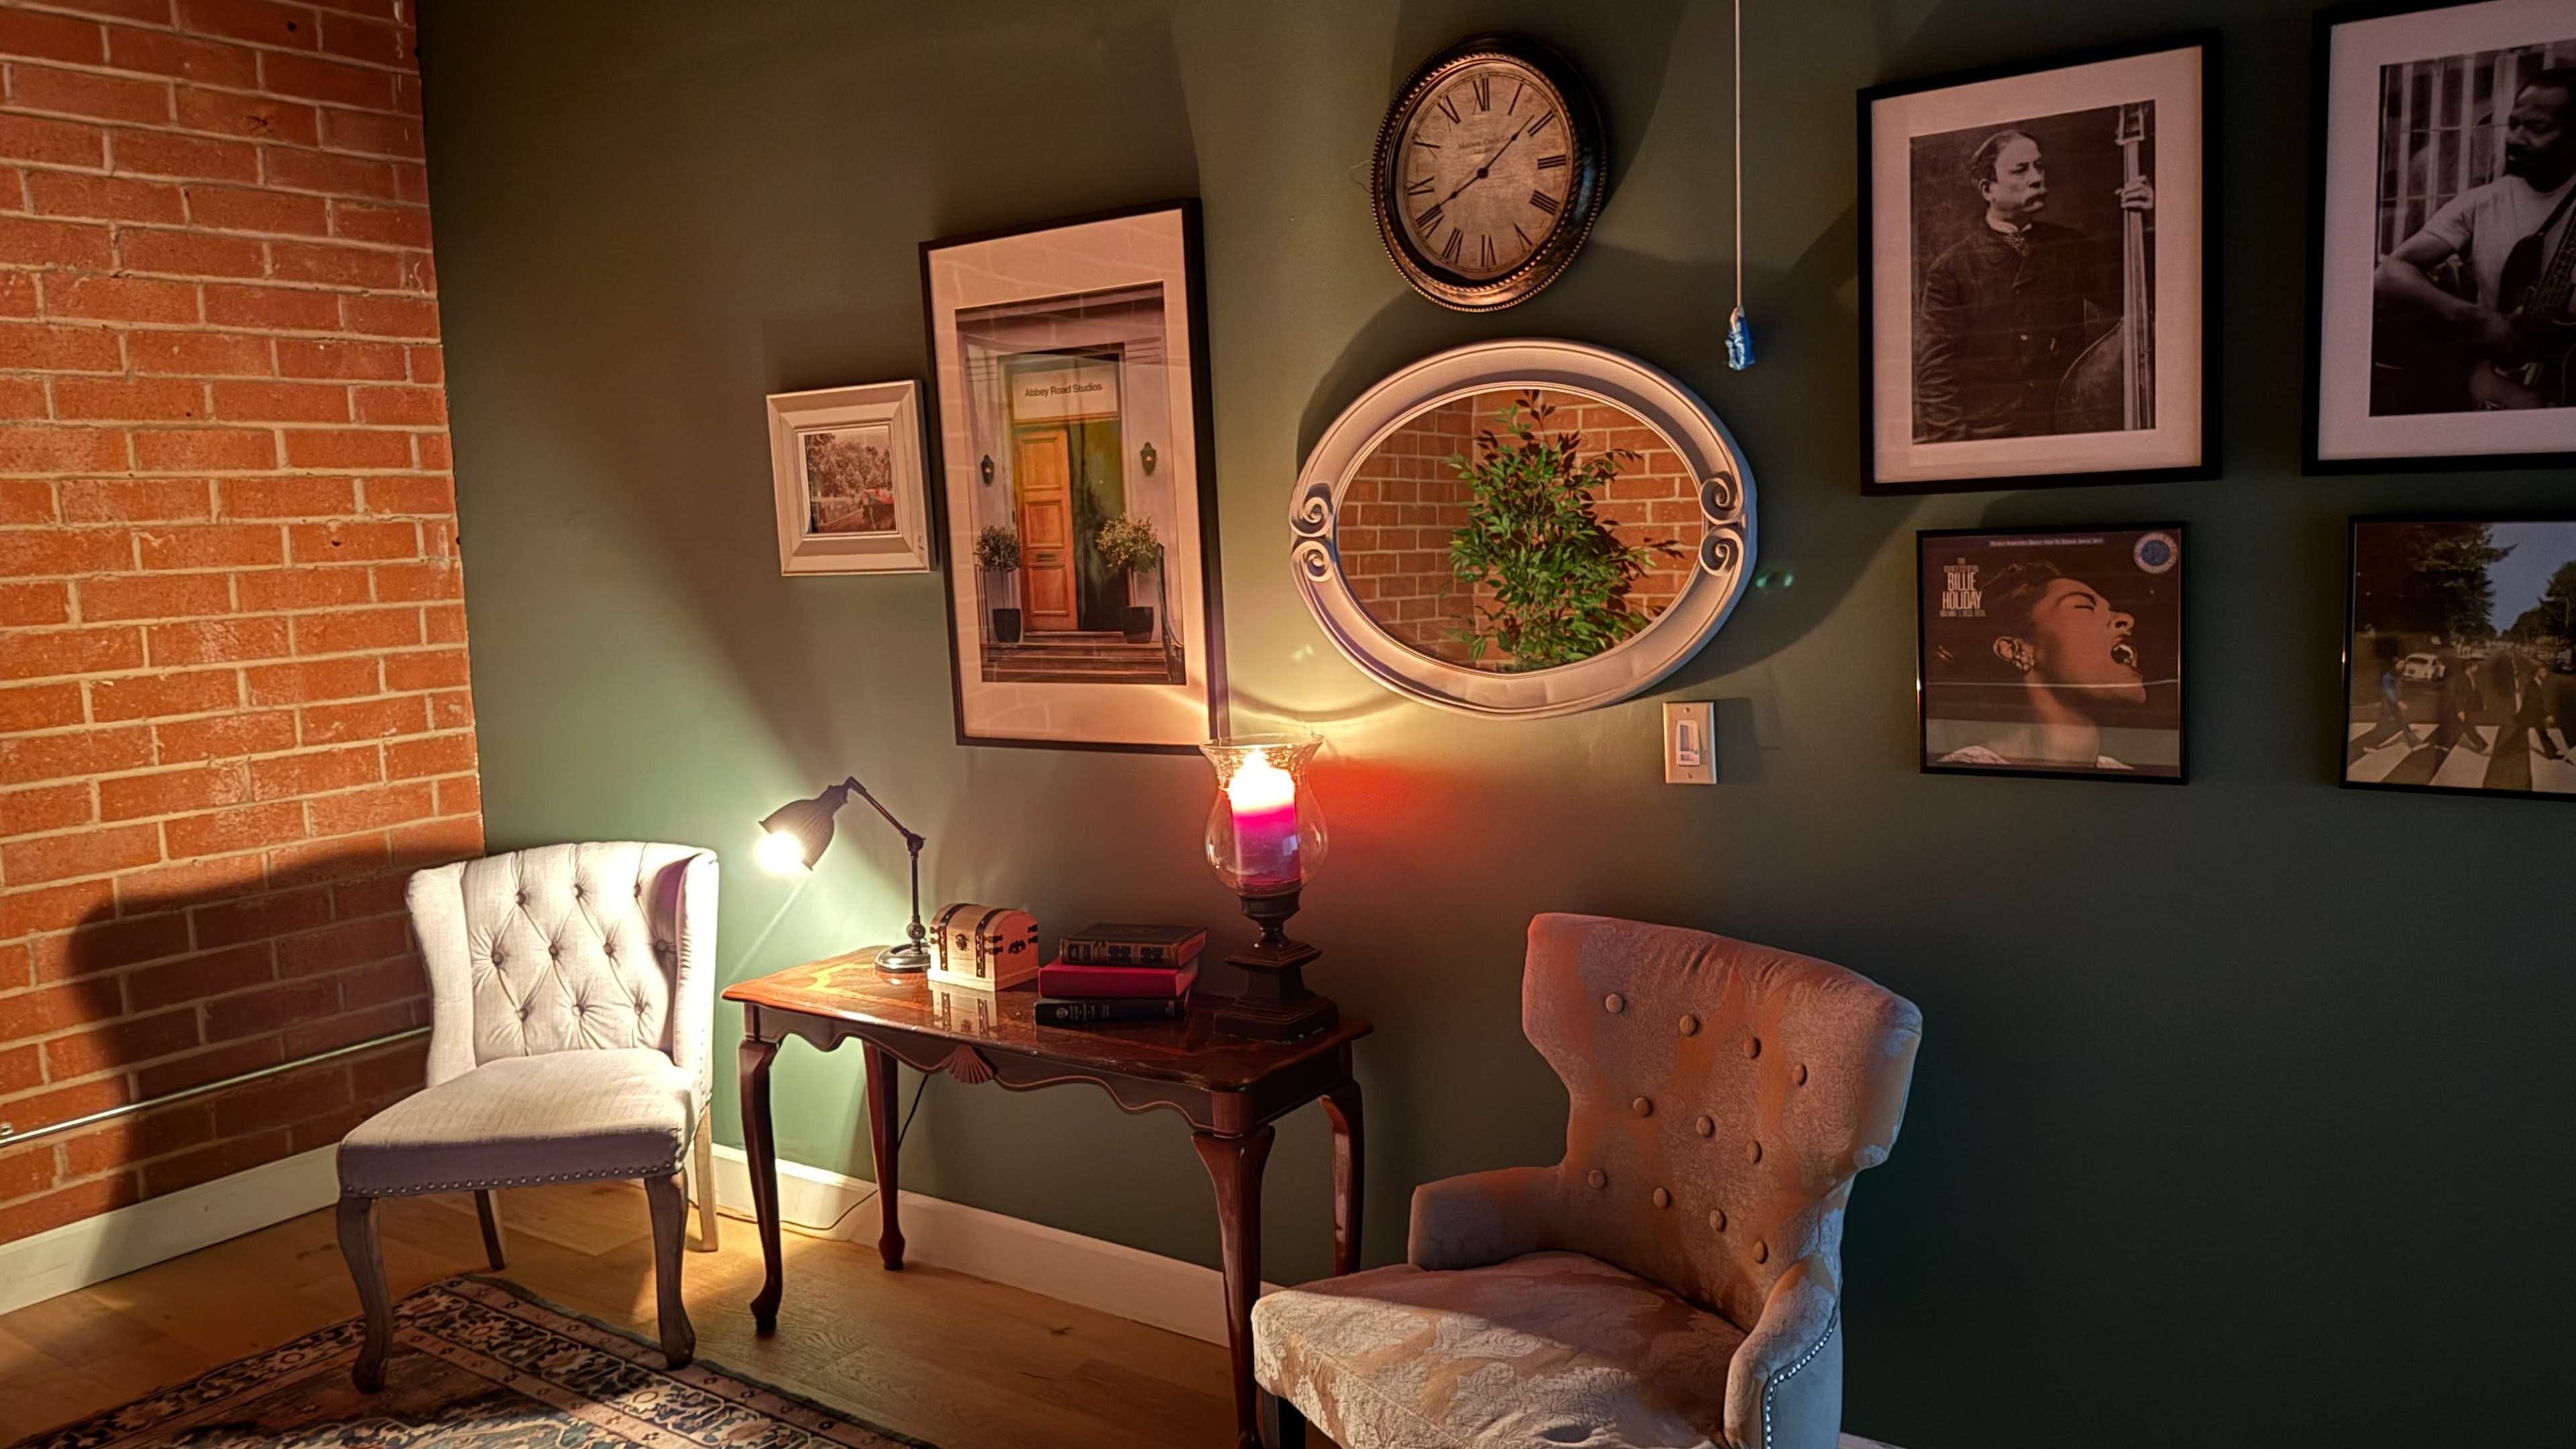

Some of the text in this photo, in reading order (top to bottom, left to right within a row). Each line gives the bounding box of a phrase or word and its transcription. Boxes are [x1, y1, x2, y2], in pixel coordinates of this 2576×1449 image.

[1537, 154, 1567, 171] III
[1024, 382, 1103, 397] Abbey Road Studios
[1947, 572, 1977, 591] BILLIE
[1942, 590, 1982, 610] HOLIDAY
